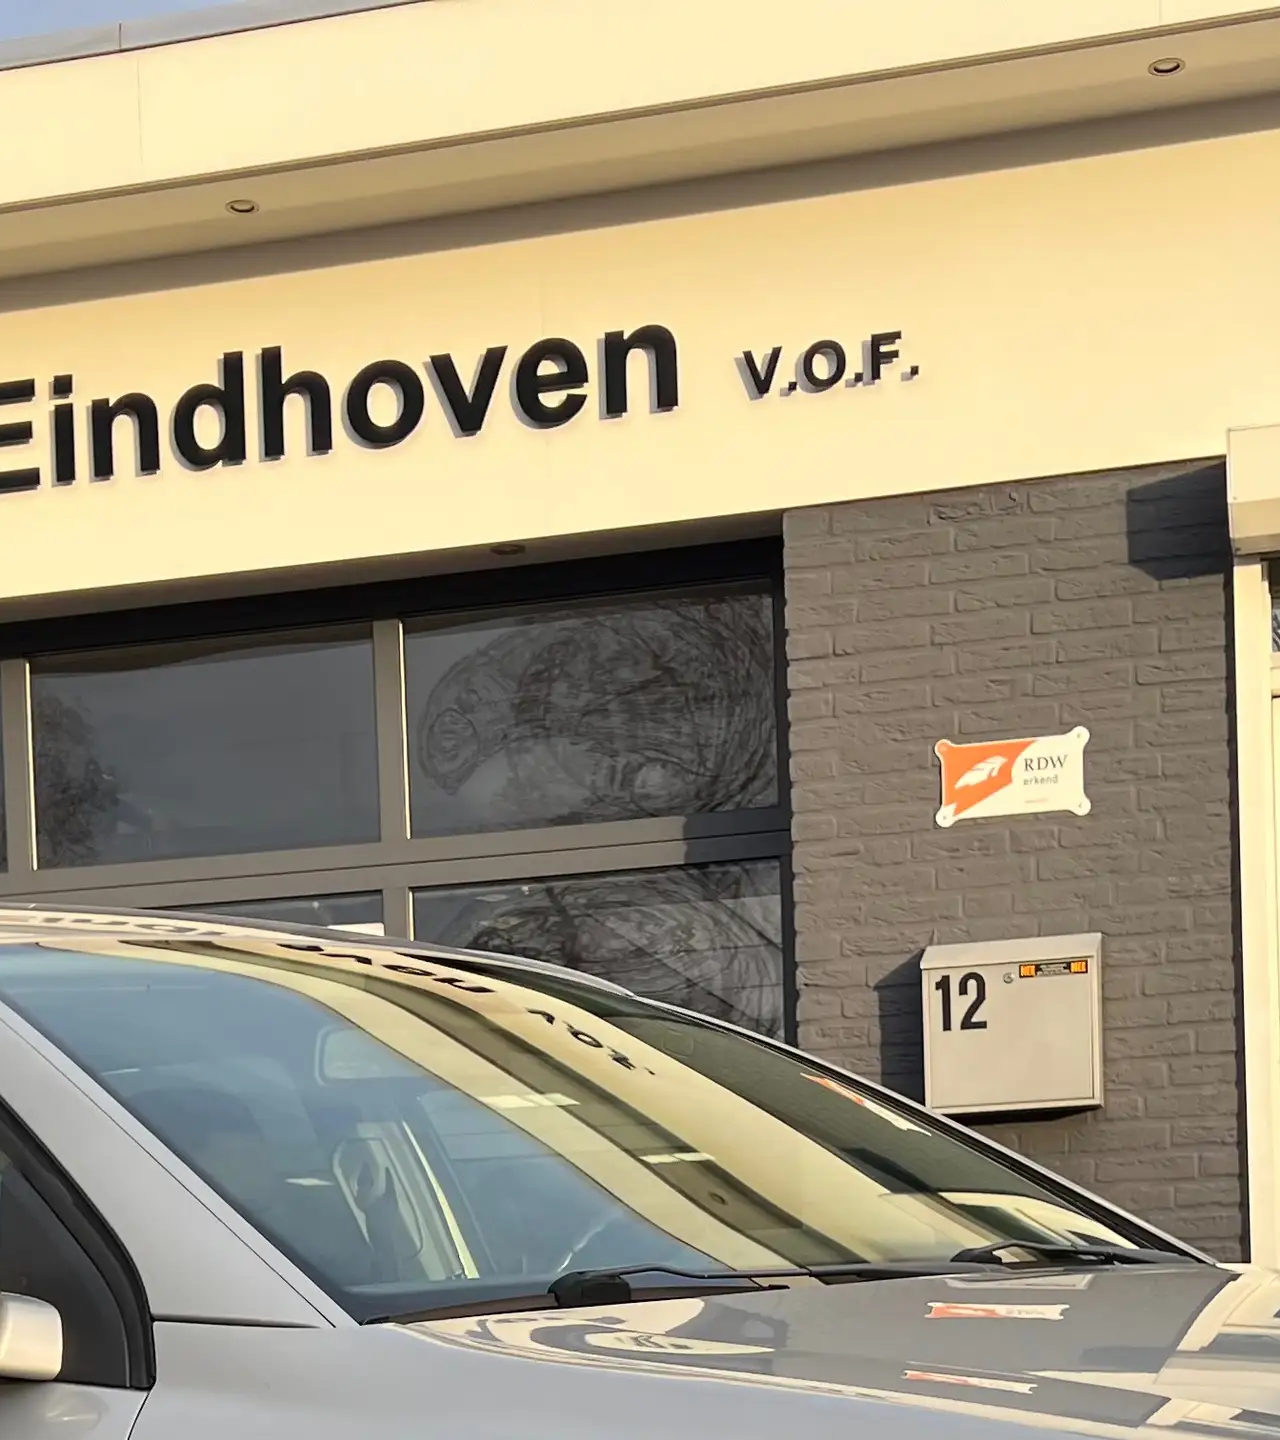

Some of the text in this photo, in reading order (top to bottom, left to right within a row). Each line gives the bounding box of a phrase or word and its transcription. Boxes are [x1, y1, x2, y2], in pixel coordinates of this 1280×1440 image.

[740, 330, 919, 397] V.O.F.
[1023, 753, 1069, 772] RDW
[1023, 773, 1059, 786] erkend
[934, 972, 988, 1032] 12
